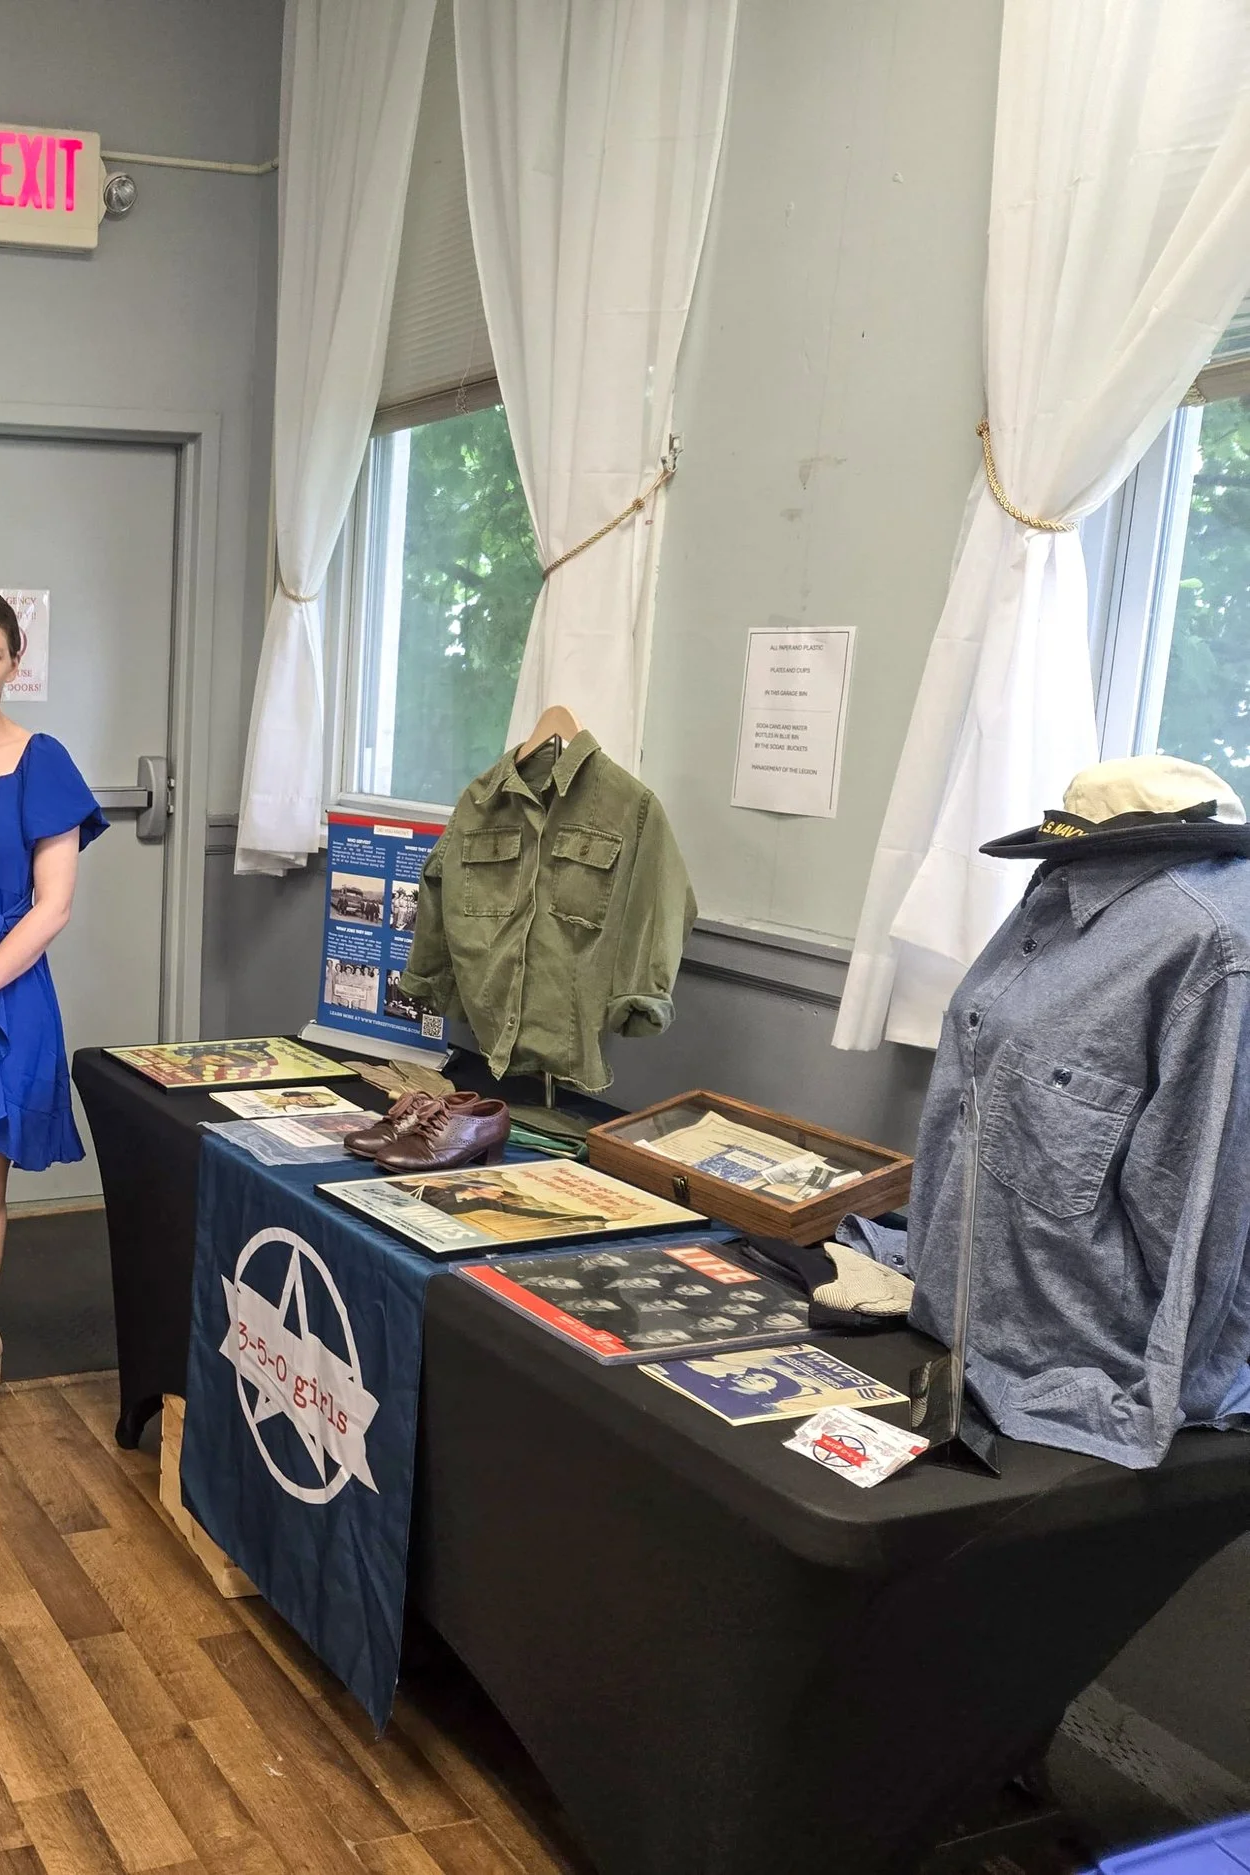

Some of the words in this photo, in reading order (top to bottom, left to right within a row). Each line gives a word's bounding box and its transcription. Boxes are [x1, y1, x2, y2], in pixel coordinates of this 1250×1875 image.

[17, 669, 33, 678] USE
[7, 683, 42, 692] DOORS!
[751, 764, 782, 772] MANAGEMENT
[1051, 823, 1089, 838] NAVY
[342, 1012, 355, 1020] MORE
[395, 1205, 478, 1239] WAVES
[675, 1247, 753, 1282] LIFE
[807, 1352, 869, 1385] WAVES
[238, 1321, 287, 1382] 3-5-0
[295, 1375, 347, 1434] girls
